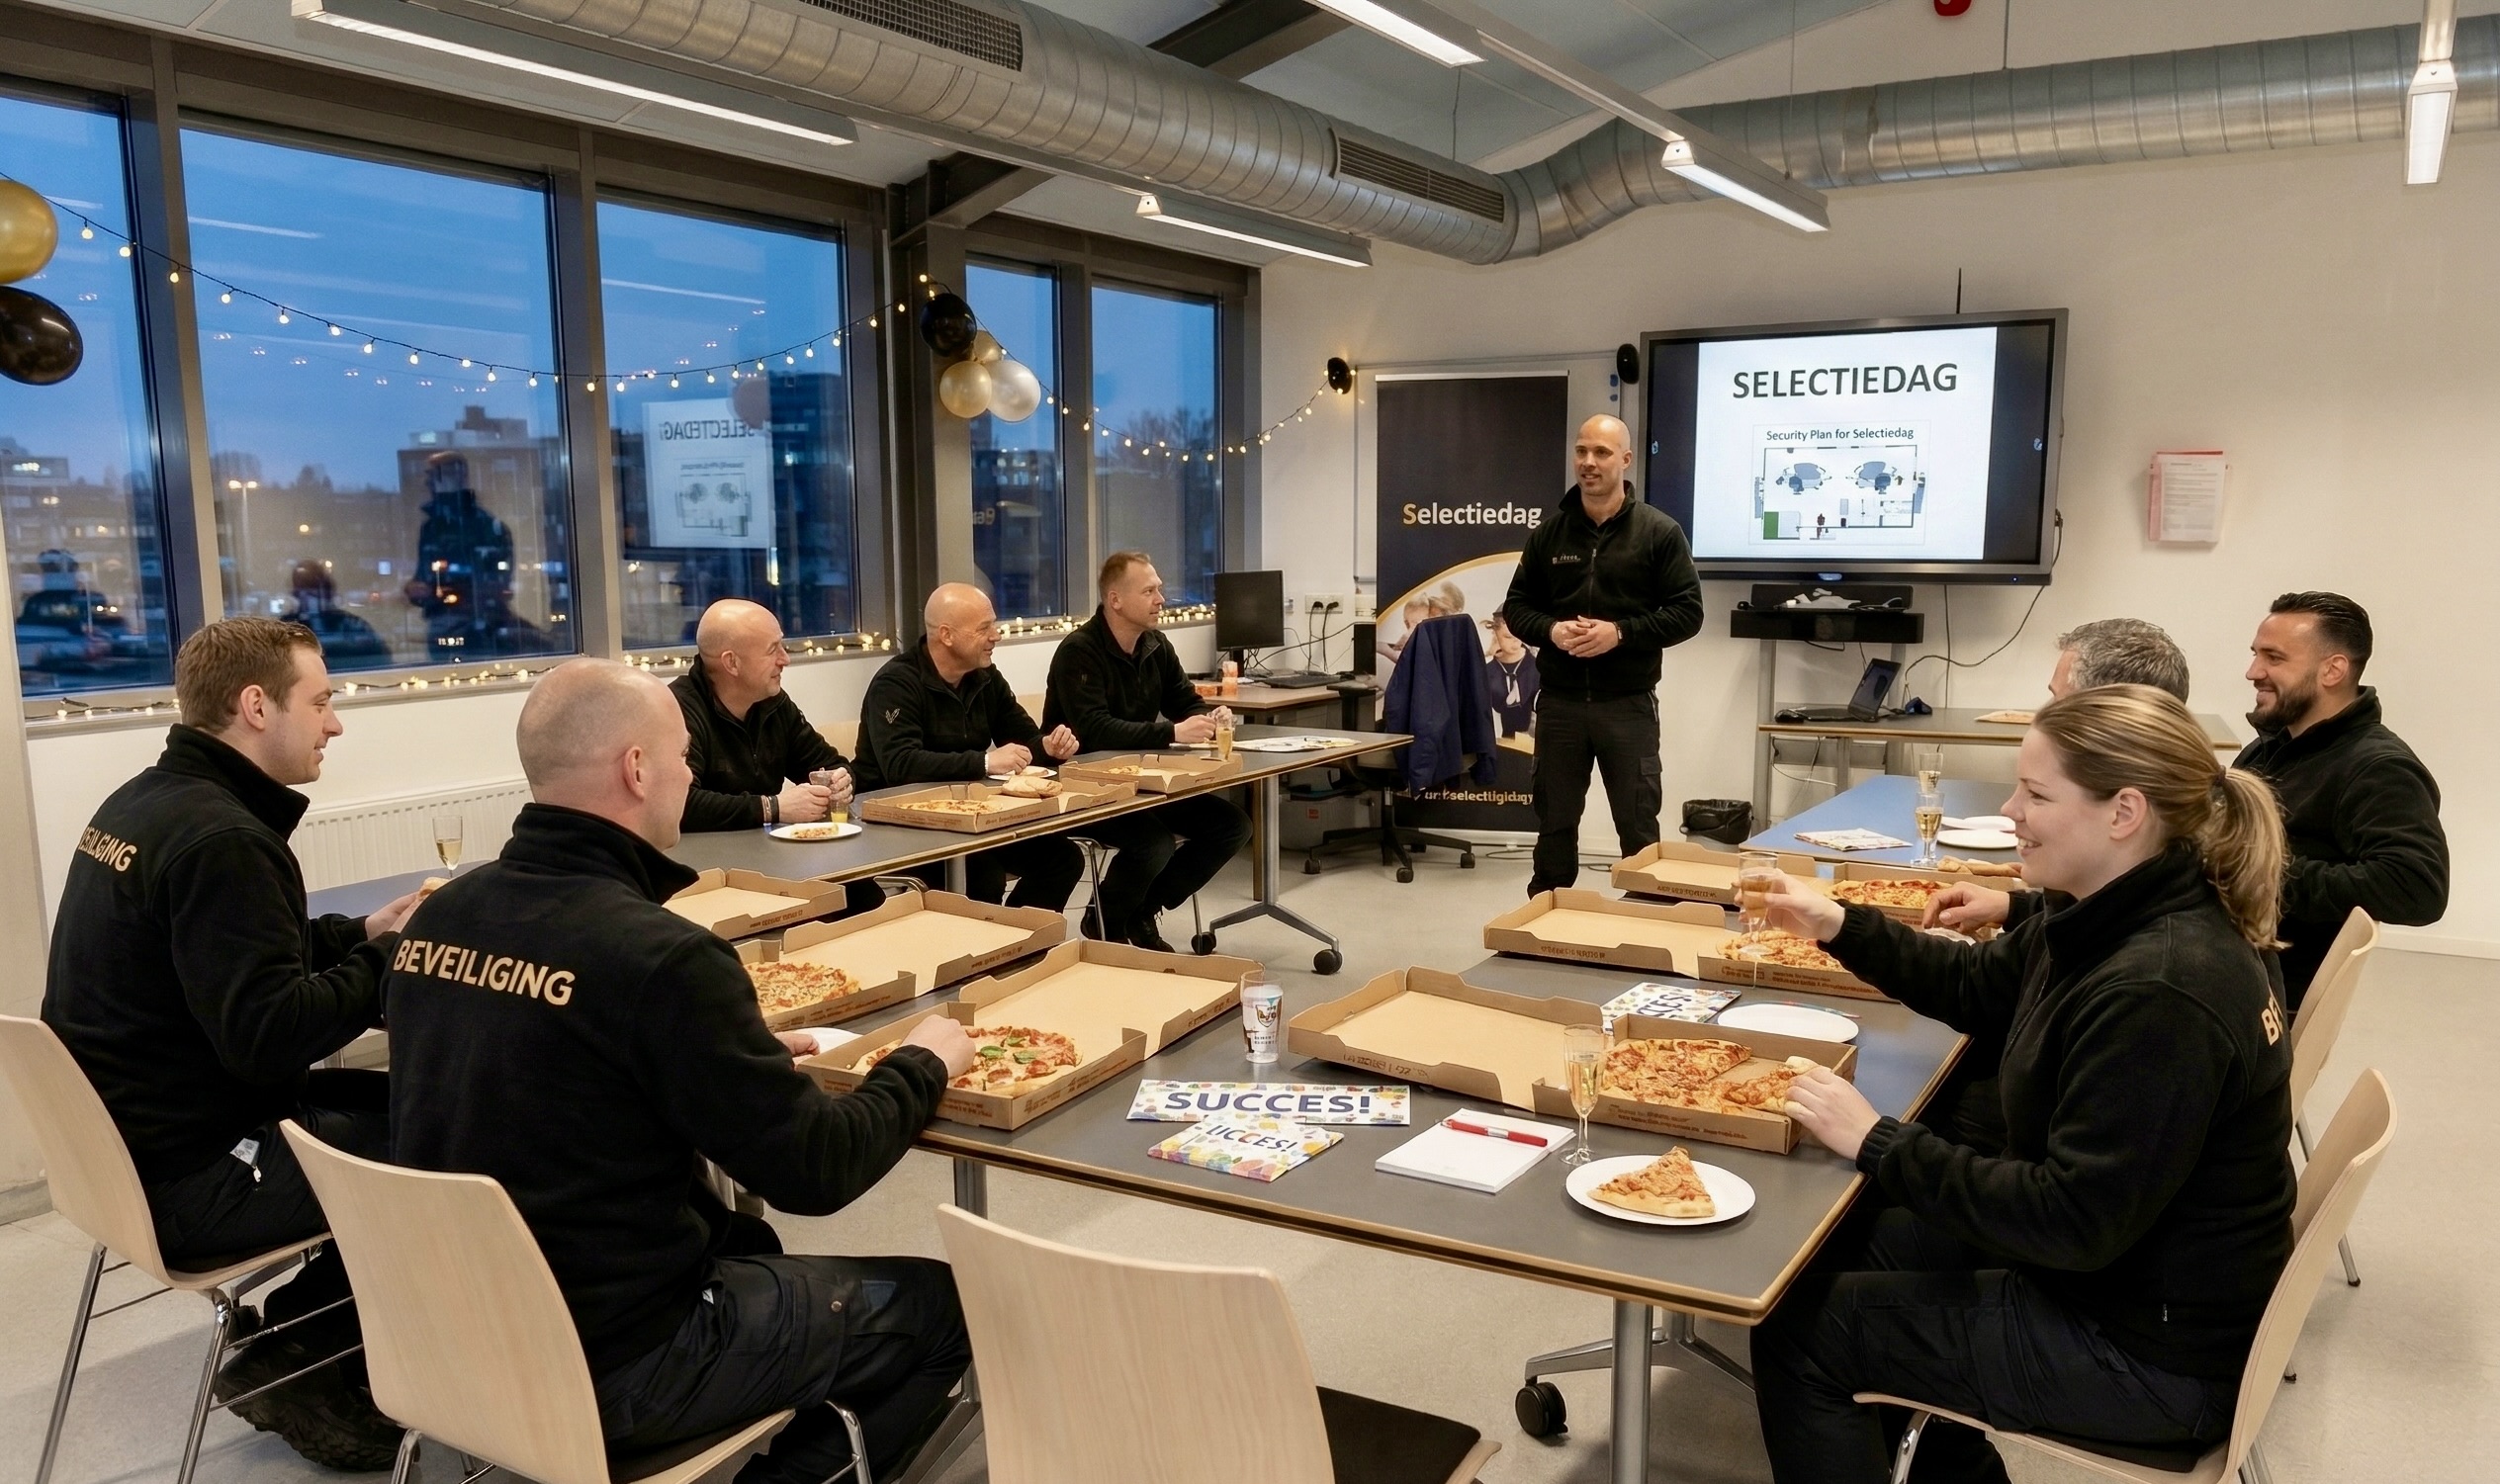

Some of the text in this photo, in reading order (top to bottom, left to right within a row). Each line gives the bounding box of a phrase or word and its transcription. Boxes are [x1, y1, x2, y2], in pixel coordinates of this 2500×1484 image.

[1733, 363, 1957, 398] SELECTIEDAG
[1766, 427, 1915, 441] Security Plan for Selectiedag
[1403, 501, 1543, 529] Selectiedag
[394, 939, 576, 1005] BEVEILIGING
[1164, 1091, 1371, 1114] SUCCES!
